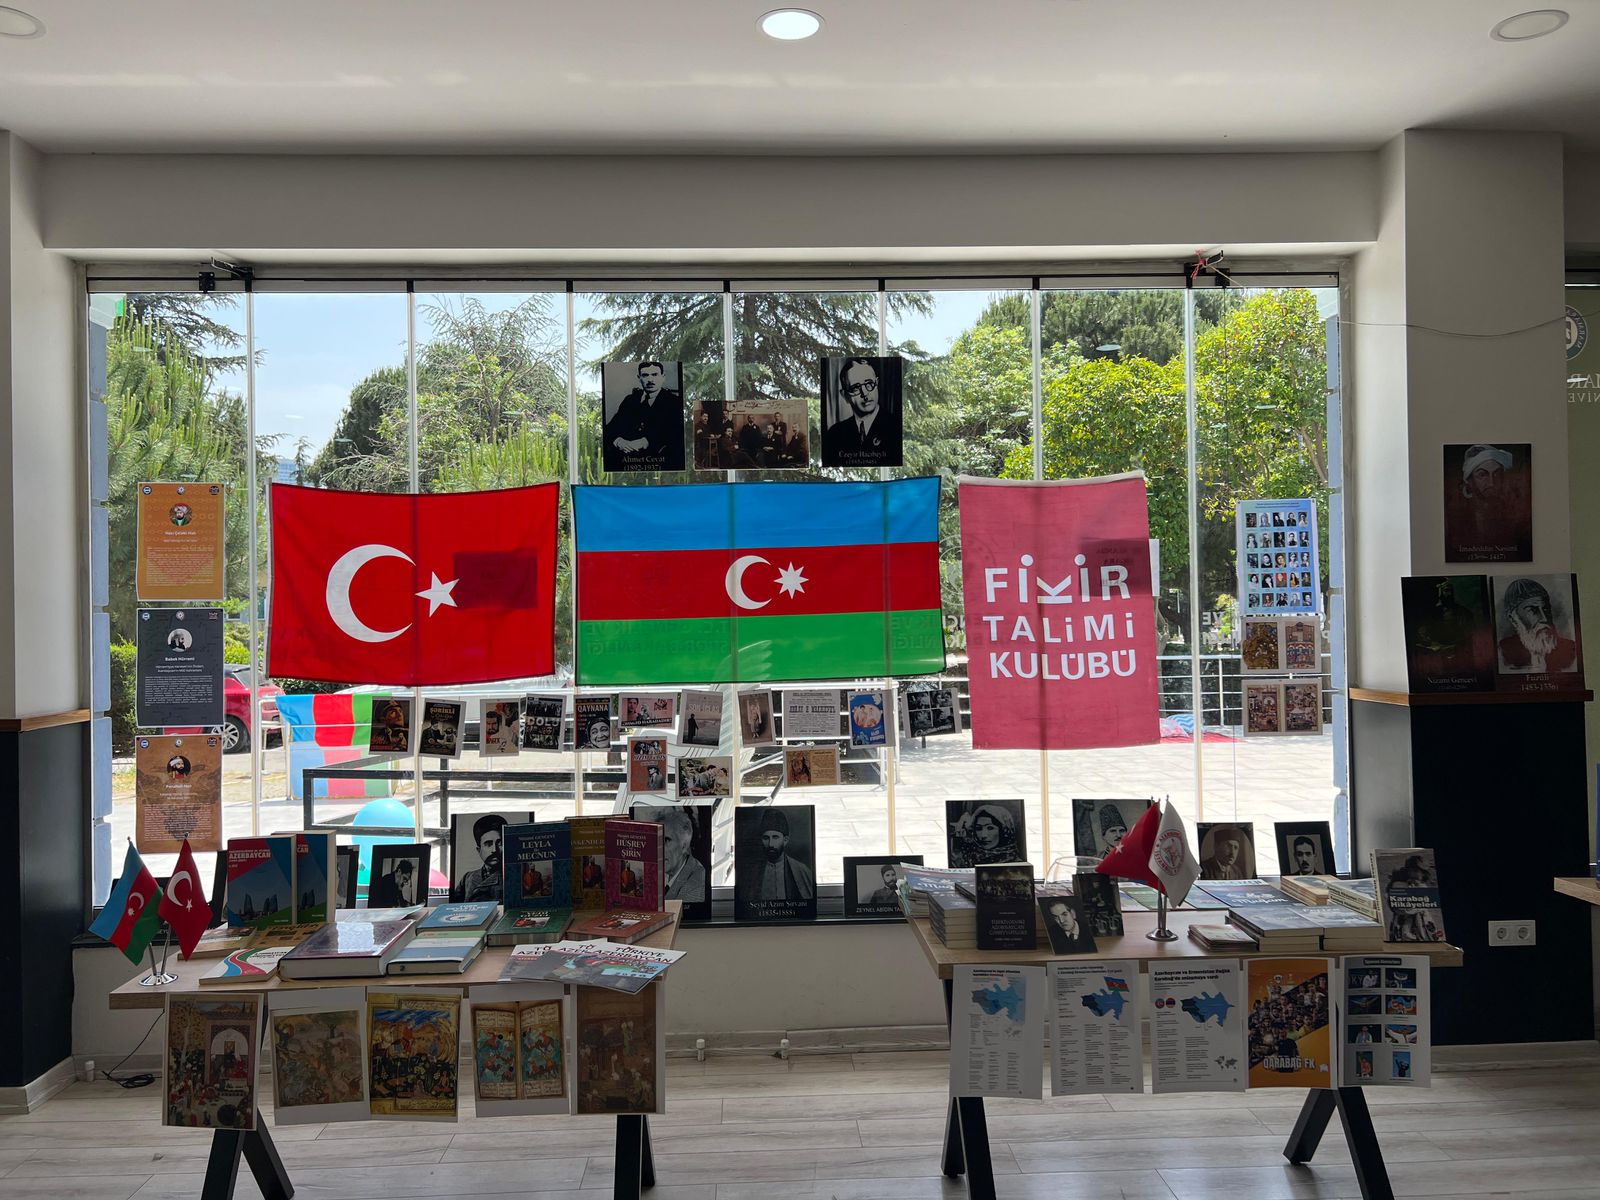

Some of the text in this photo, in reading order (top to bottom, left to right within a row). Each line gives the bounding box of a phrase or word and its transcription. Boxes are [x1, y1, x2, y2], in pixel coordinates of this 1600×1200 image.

[623, 456, 665, 464] Ahmet Cevat
[984, 554, 1131, 605] FİKİR
[989, 649, 1137, 681] KULÜBÜ
[577, 704, 609, 713] QAYNANA
[522, 840, 552, 849] LEYLA
[517, 851, 557, 861] MECNUN
[1390, 895, 1430, 903] Karabağ
[750, 901, 767, 909] Seyid
[1390, 901, 1438, 910] Hikâyeleri
[615, 945, 665, 957] TÜRKİYE
[593, 949, 673, 963] AZERBAYCAN
[1263, 1056, 1317, 1069] QARABAĞ FK
